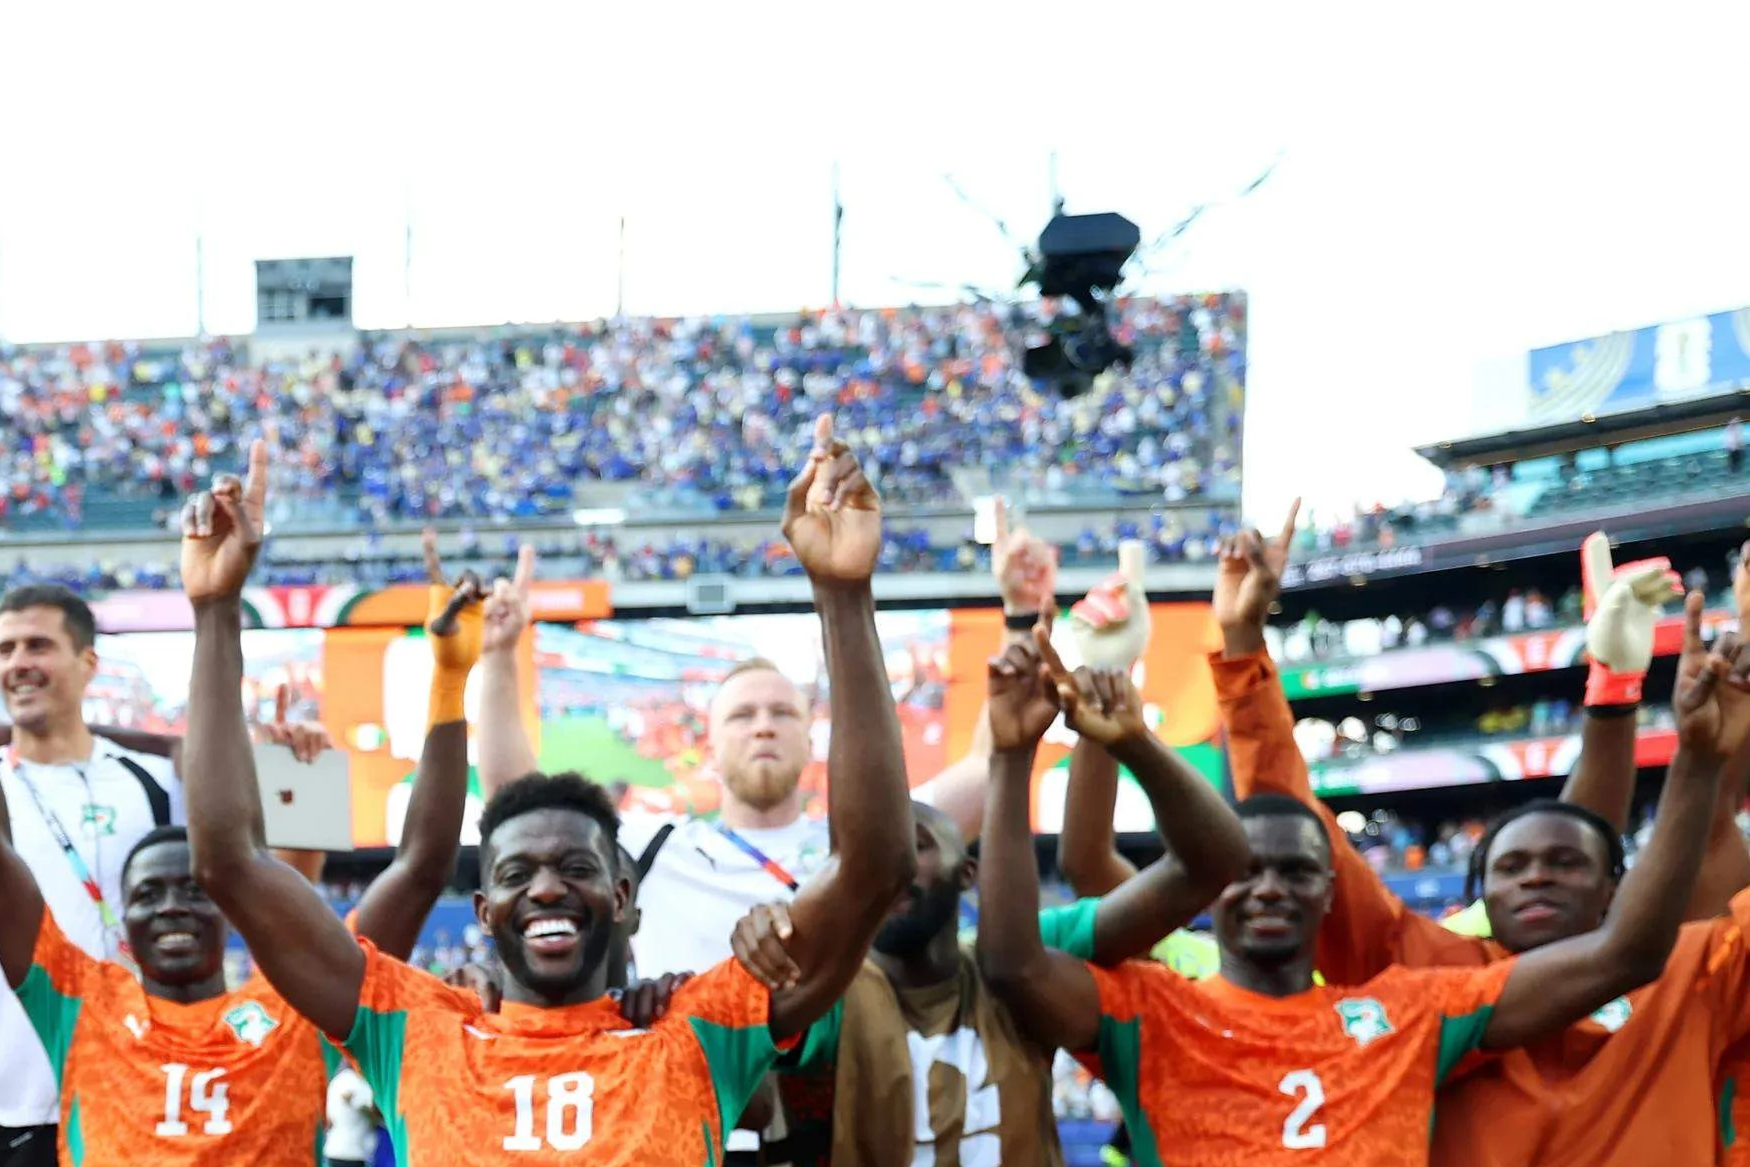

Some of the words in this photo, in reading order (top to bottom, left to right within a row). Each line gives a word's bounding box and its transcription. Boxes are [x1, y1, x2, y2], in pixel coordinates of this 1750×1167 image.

[155, 1063, 233, 1136] 14
[502, 1071, 594, 1150] 18
[1278, 1068, 1327, 1149] 2
